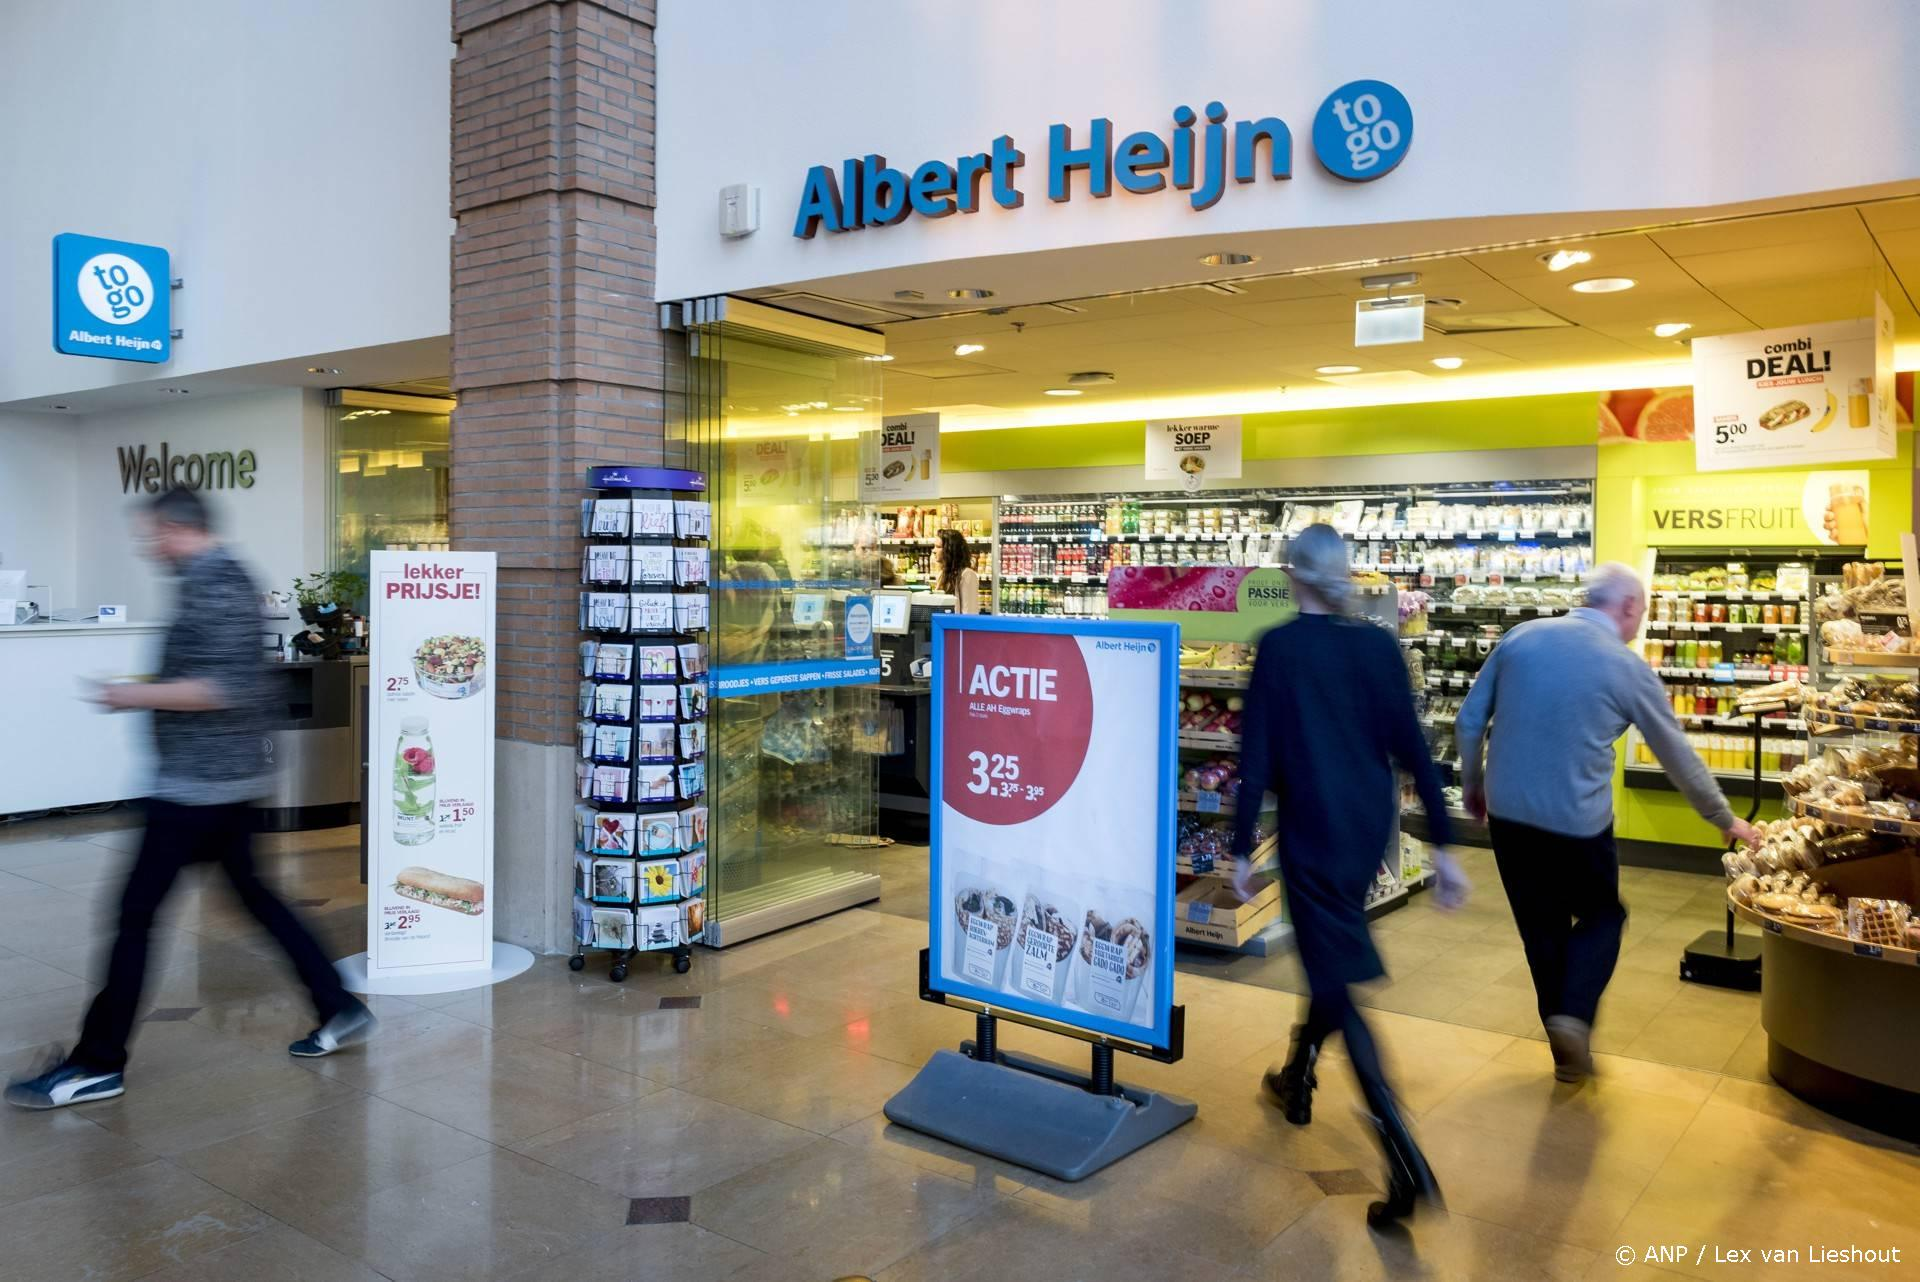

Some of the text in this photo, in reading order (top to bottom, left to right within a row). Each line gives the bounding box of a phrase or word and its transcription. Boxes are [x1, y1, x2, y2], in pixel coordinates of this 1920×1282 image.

[1331, 93, 1383, 128] to
[1345, 119, 1401, 172] go
[793, 100, 1294, 240] Albert Heijn
[93, 264, 129, 290] to
[106, 285, 145, 319] go
[69, 329, 150, 351] Albert Heijn
[1764, 337, 1812, 355] combi
[1746, 350, 1831, 380] DEAL!
[1797, 376, 1822, 385] LUNCH
[886, 422, 907, 431] combi
[1166, 424, 1192, 432] lekker
[1175, 432, 1211, 445] SOEP
[117, 441, 257, 495] Welcome
[403, 562, 464, 581] lekker
[386, 582, 481, 601] PRIJSJE!
[1248, 588, 1289, 600] PASSIE
[1095, 640, 1147, 654] Albert Heijn
[882, 657, 892, 677] 5
[386, 676, 409, 691] 2.75
[754, 677, 769, 686] VERS
[770, 675, 799, 685] GEPERSTE
[799, 672, 821, 681] SAPPEN
[825, 670, 842, 680] FRISSE
[968, 664, 1058, 702] ACTIE
[969, 702, 986, 712] ALLE
[986, 703, 997, 713] AH
[998, 704, 1031, 717] Eggwraps
[966, 750, 1020, 797] 3.25
[453, 807, 475, 822] 1.50
[398, 914, 421, 930] 2.95
[1185, 926, 1224, 940] Albert Heijn
[1025, 944, 1048, 961] ZALM
[1093, 956, 1125, 976] GADO GADO
